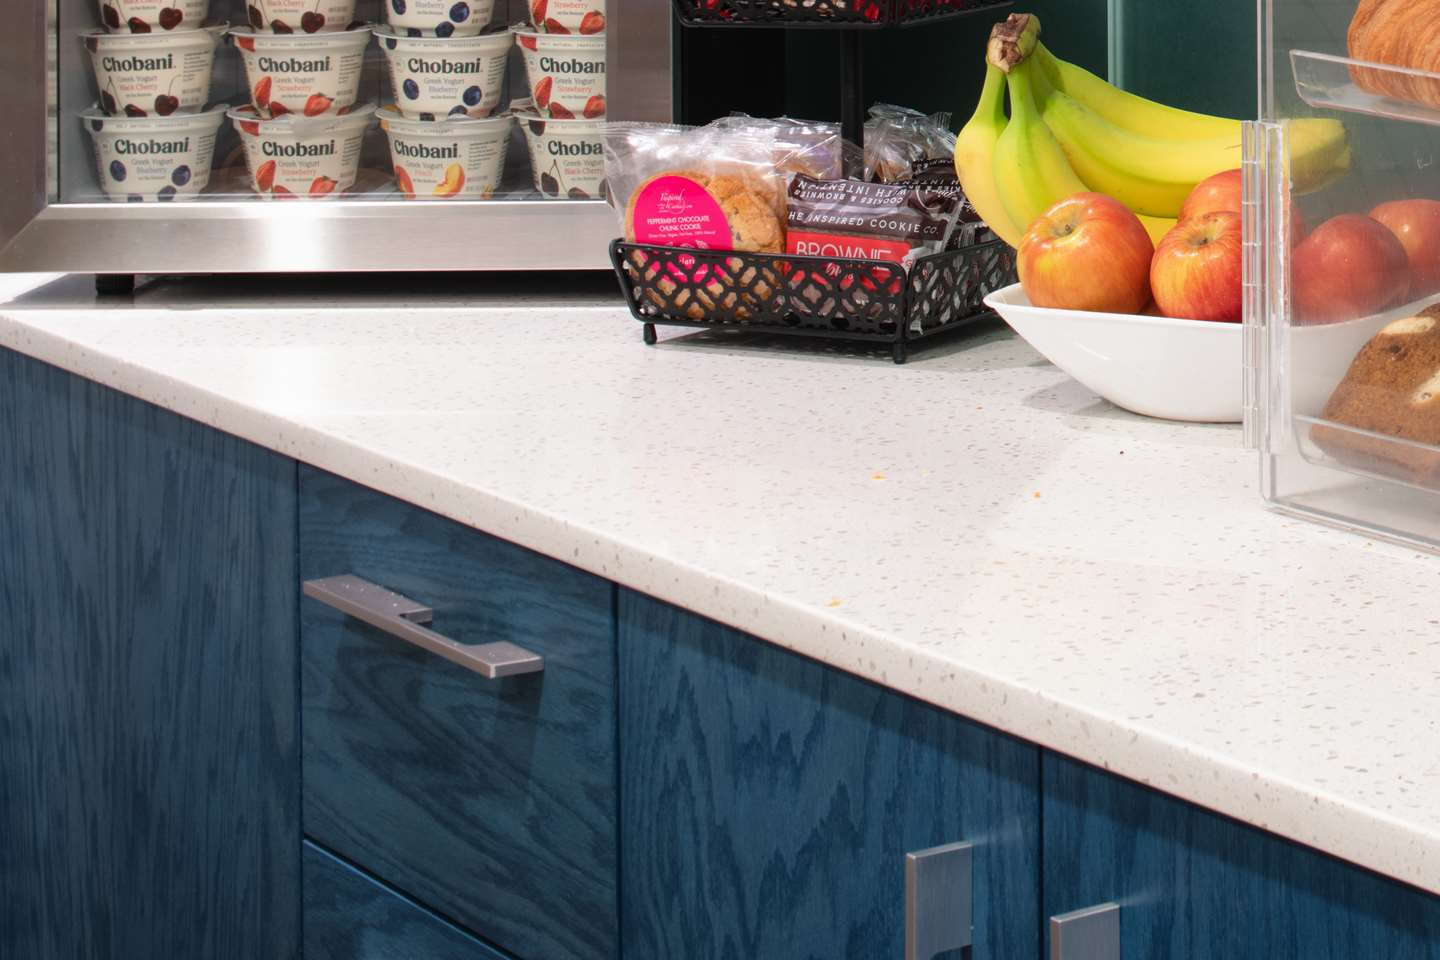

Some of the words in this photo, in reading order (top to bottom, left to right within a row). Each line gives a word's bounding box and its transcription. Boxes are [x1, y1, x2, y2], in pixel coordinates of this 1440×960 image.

[102, 53, 173, 72] Chobani
[258, 56, 331, 73] Chobani
[408, 58, 481, 74] Chobani
[540, 56, 605, 74] Choban
[114, 137, 189, 154] Chobani
[262, 139, 335, 157] Chobani
[394, 140, 458, 159] Chobani
[547, 140, 603, 156] Choba
[794, 189, 846, 201] BROWNIES
[861, 196, 903, 205] COOKIES
[875, 188, 907, 198] WITH
[647, 217, 677, 225] PEPPERMINT
[678, 215, 710, 223] CHOCOLATE
[807, 213, 864, 227] INSPIRED
[870, 218, 920, 233] COOKIE
[923, 225, 939, 234] CO.
[797, 241, 892, 259] BROWNIE
